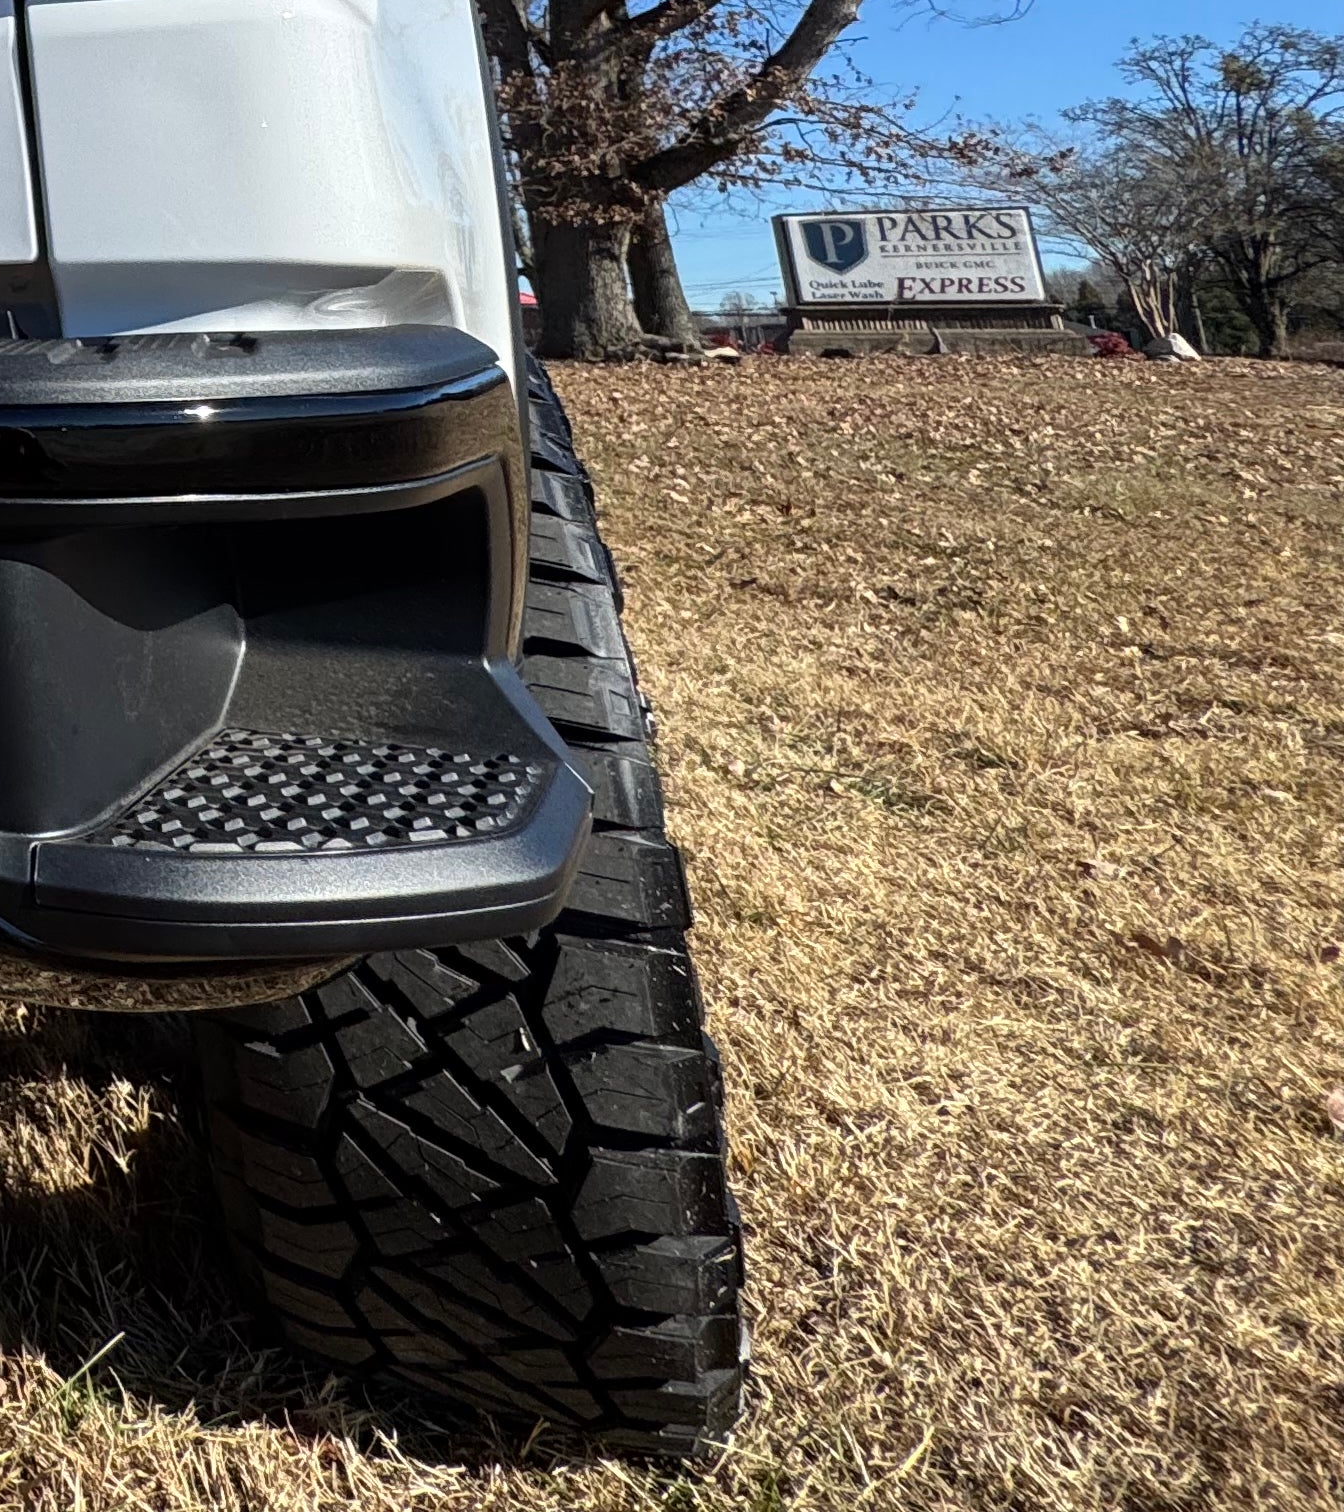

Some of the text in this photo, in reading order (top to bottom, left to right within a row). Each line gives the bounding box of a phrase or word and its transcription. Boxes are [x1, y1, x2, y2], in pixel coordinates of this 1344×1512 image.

[876, 212, 1018, 242] PARKS
[819, 222, 854, 263] P
[878, 241, 1023, 253] KERNERSVILLE
[915, 259, 996, 271] BUICK GMC
[809, 279, 885, 290] Quick Lube
[896, 275, 1026, 300] EXPRESS
[812, 290, 885, 300] Laser Wash
